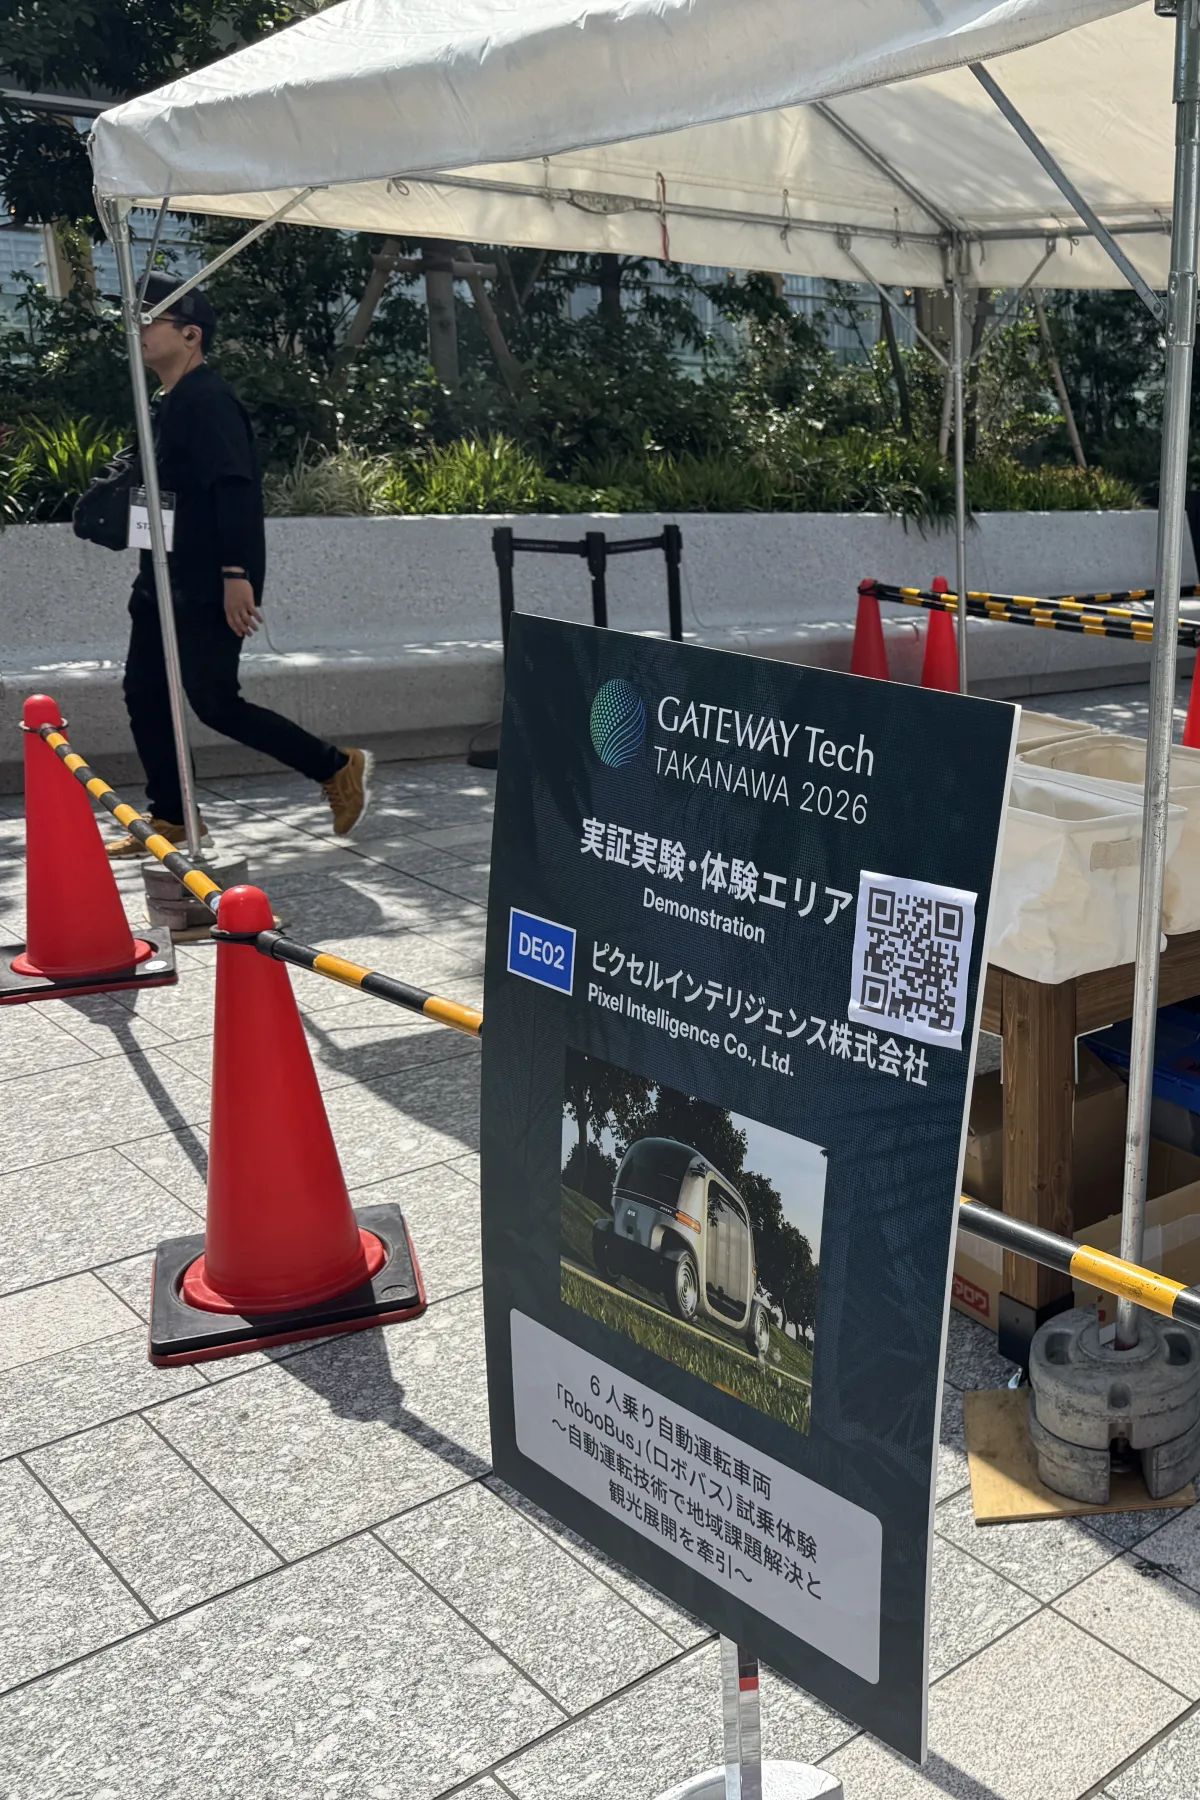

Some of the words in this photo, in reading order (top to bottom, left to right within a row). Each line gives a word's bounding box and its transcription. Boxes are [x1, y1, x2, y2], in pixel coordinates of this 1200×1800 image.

[657, 696, 799, 758] GATEWAY
[804, 725, 874, 776] Tech
[653, 745, 789, 806] TAKANAWA
[800, 781, 868, 824] 2026
[580, 817, 853, 925] 実証実験・体験エリア
[518, 932, 566, 971] DE02
[643, 887, 766, 944] Demonstration
[588, 982, 623, 1014] Pixel
[626, 993, 720, 1051] Intelligence
[724, 1032, 757, 1066] Co.,
[761, 1046, 794, 1076] Ltd.
[592, 940, 929, 1086] ピクセルインテリジェンス株式会社
